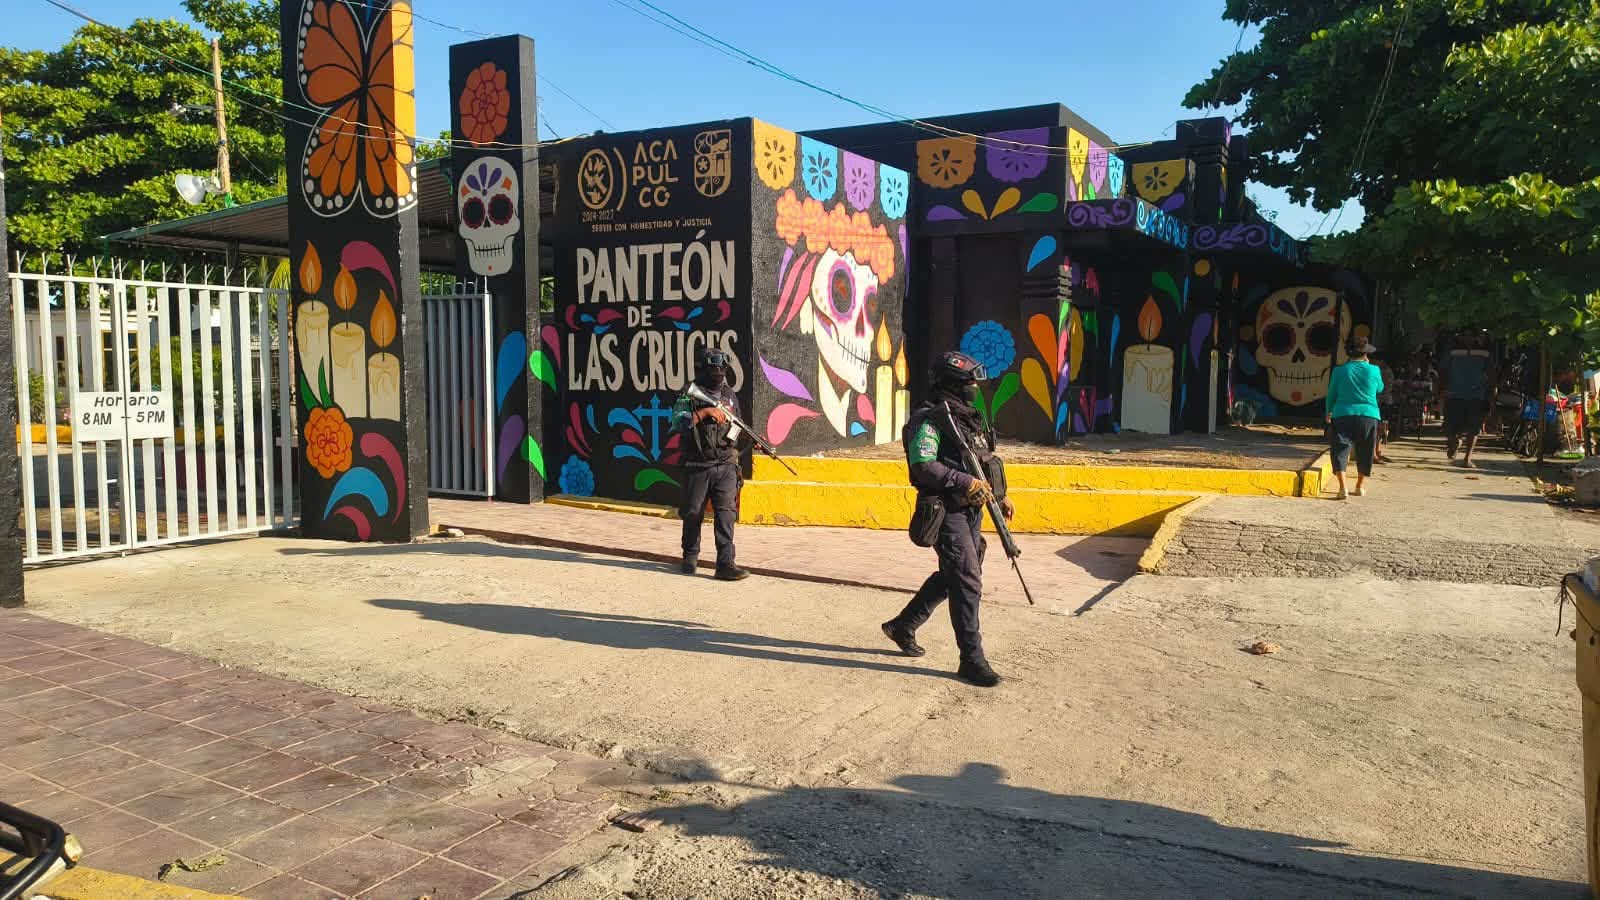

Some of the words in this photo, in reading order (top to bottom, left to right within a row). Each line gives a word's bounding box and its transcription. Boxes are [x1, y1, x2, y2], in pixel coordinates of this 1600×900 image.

[634, 139, 678, 164] ACA
[633, 163, 679, 186] PUL
[591, 223, 612, 233] SERVIR
[614, 223, 627, 232] CON
[630, 220, 673, 230] HONESTIDAD
[682, 217, 712, 227] JUSTICIA
[576, 229, 735, 304] PANTEÓN
[627, 305, 653, 328] DE
[567, 332, 624, 392] LAS
[94, 395, 160, 407] Horario
